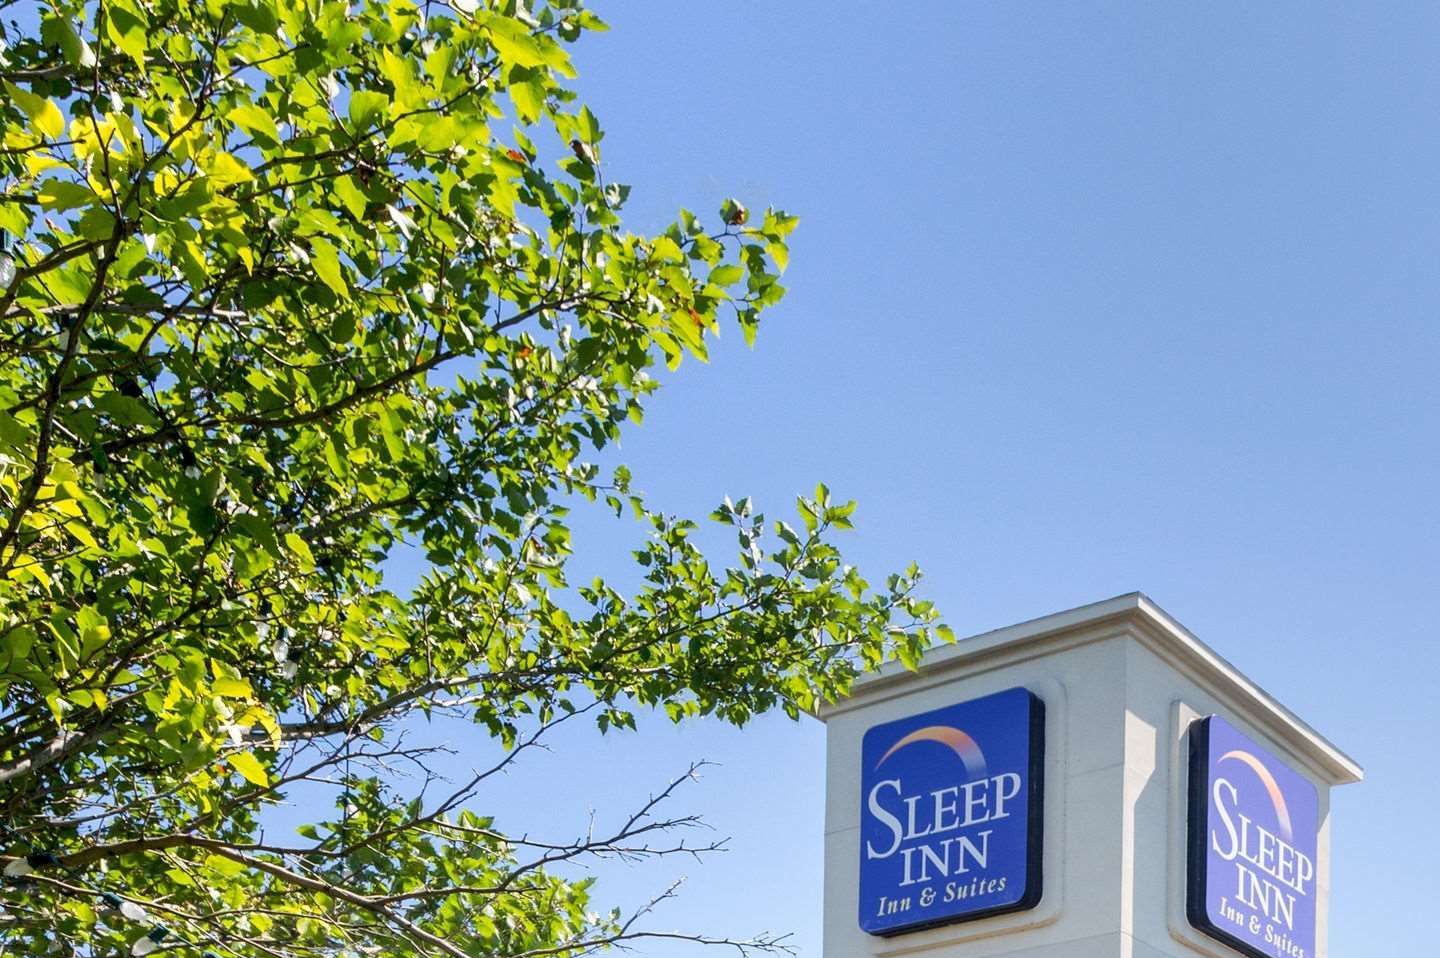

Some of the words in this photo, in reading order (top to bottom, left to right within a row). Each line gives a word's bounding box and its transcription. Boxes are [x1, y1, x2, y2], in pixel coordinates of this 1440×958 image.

[867, 772, 1021, 860] SLEEP
[1212, 778, 1313, 895] SLEEP
[898, 830, 993, 887] INN
[877, 896, 911, 917] Inn
[919, 887, 937, 908] &
[943, 875, 1007, 903] Suites
[1219, 897, 1245, 926] Inn
[1249, 914, 1262, 935] &
[1235, 863, 1296, 931] INN
